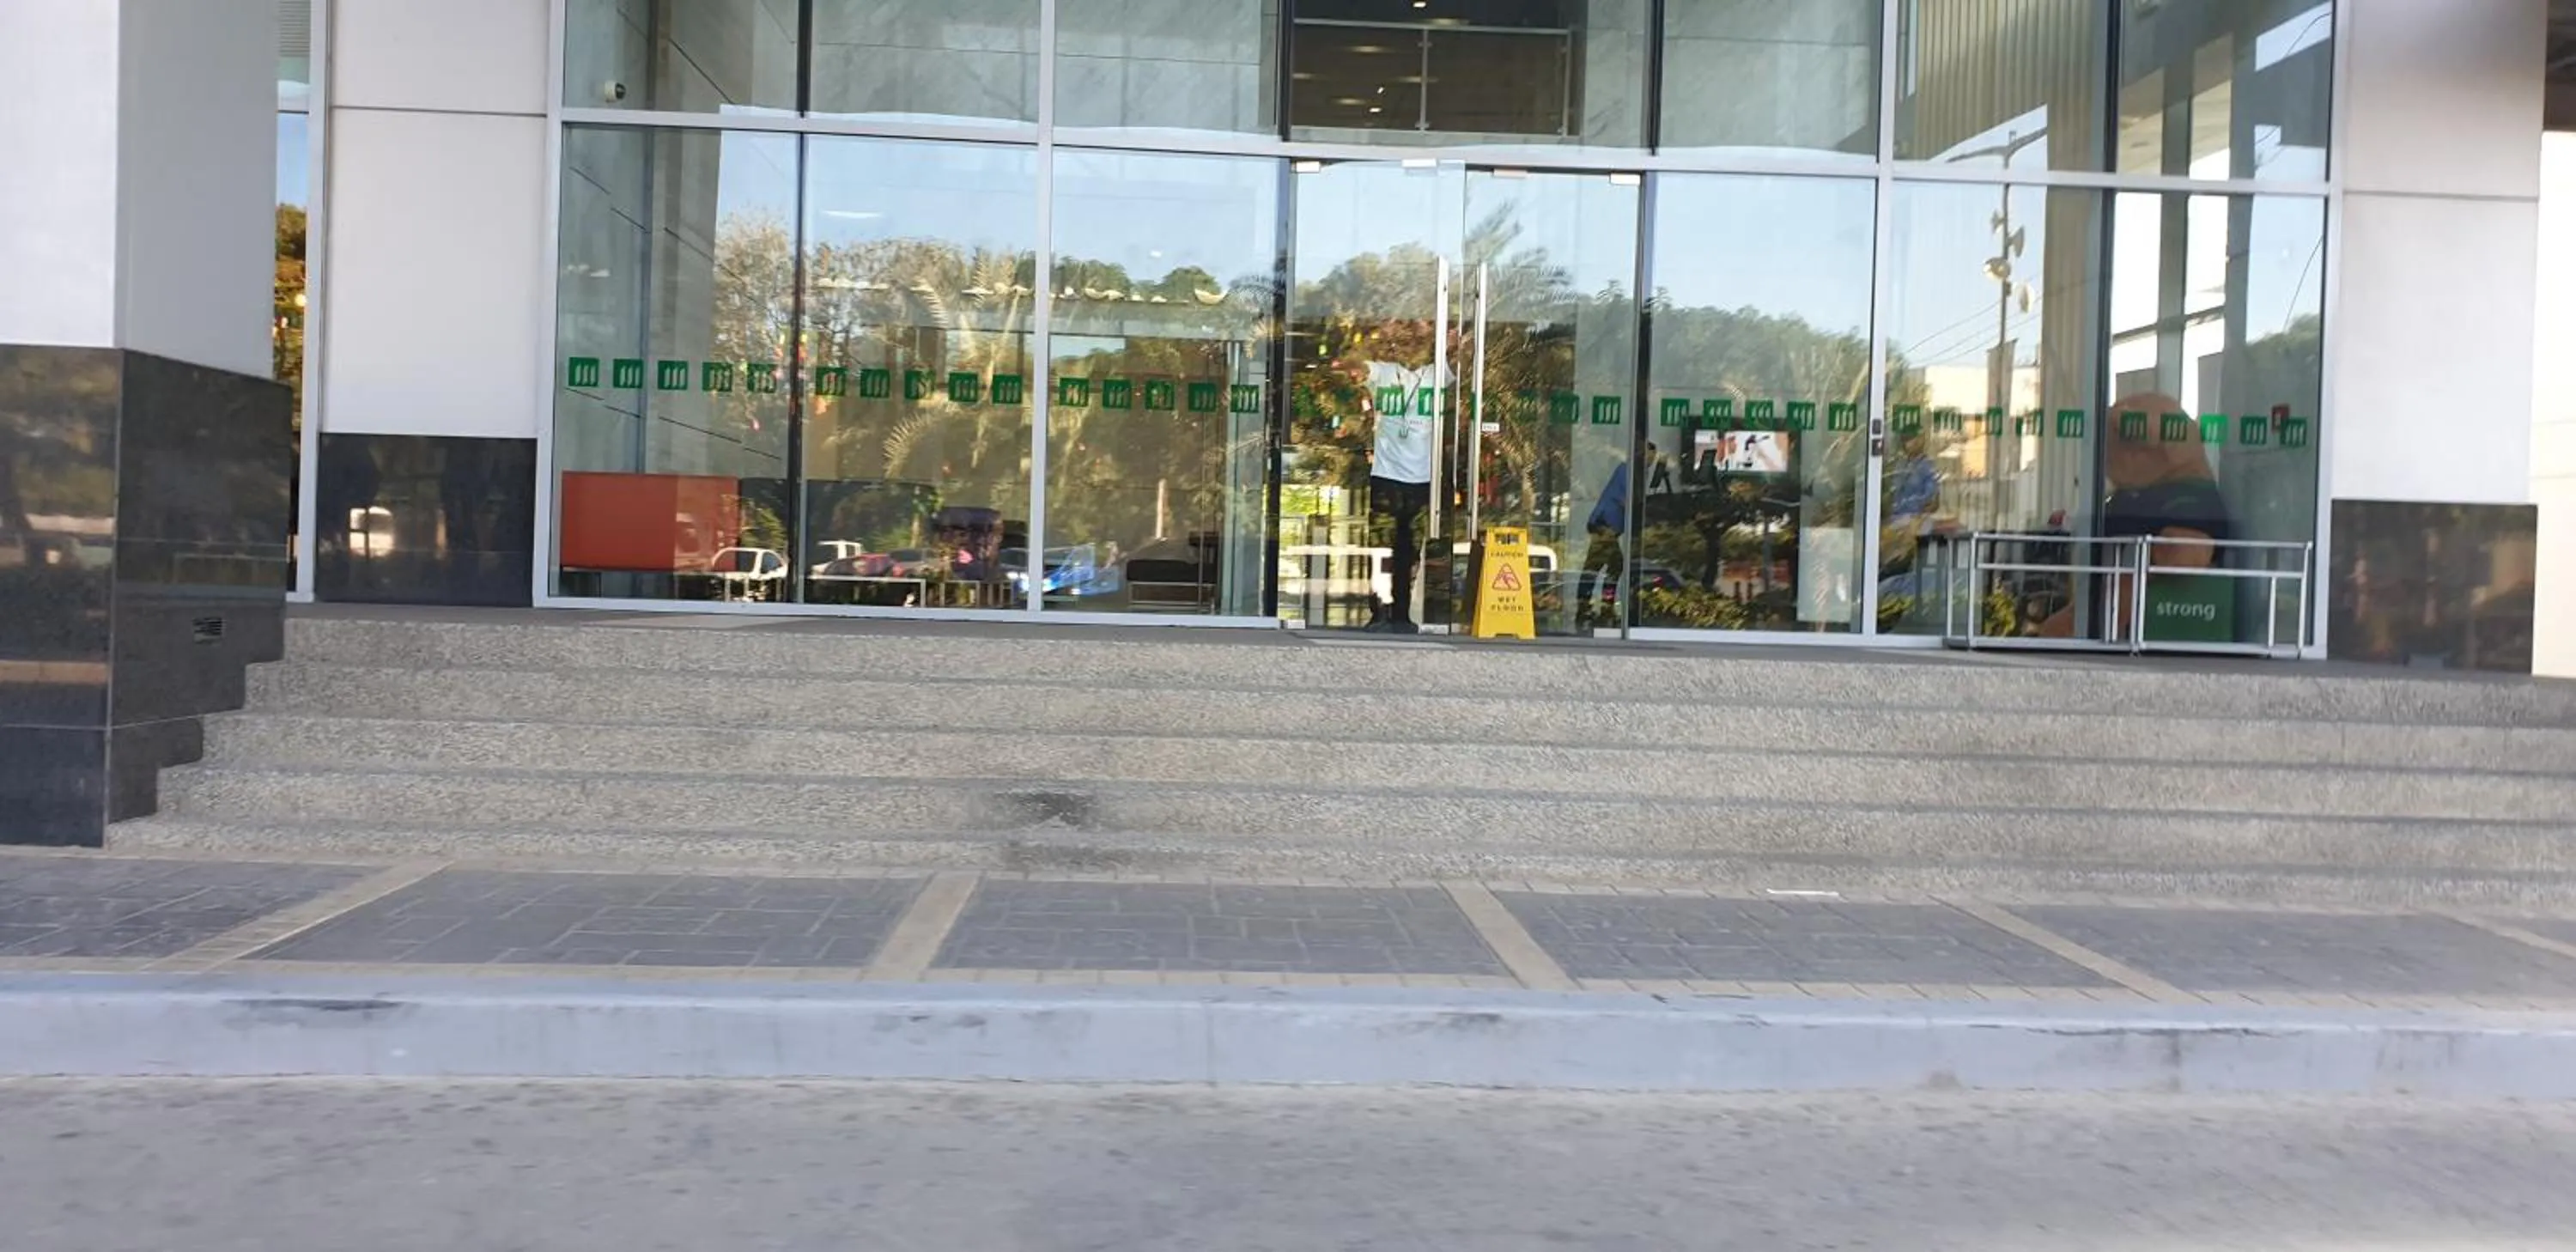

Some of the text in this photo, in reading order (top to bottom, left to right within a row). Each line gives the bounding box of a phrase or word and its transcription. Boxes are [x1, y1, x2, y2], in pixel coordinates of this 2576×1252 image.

[1497, 595, 1516, 604] WET
[1490, 604, 1525, 612] FLOOR
[2156, 602, 2215, 622] strong
